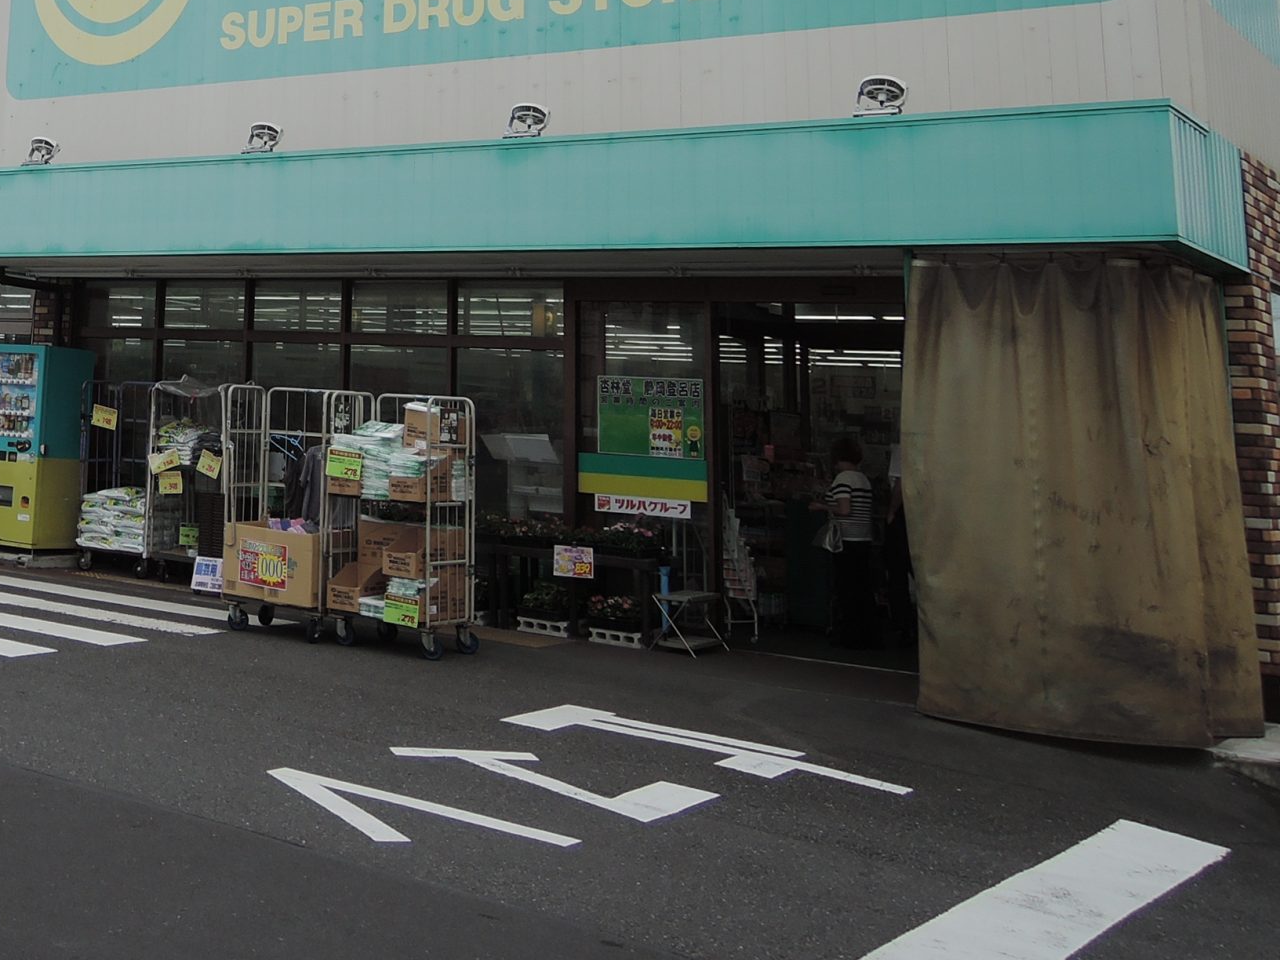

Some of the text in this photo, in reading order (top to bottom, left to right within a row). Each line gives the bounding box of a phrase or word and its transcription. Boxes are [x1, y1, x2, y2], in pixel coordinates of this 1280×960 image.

[615, 498, 689, 515] ツルハグループ
